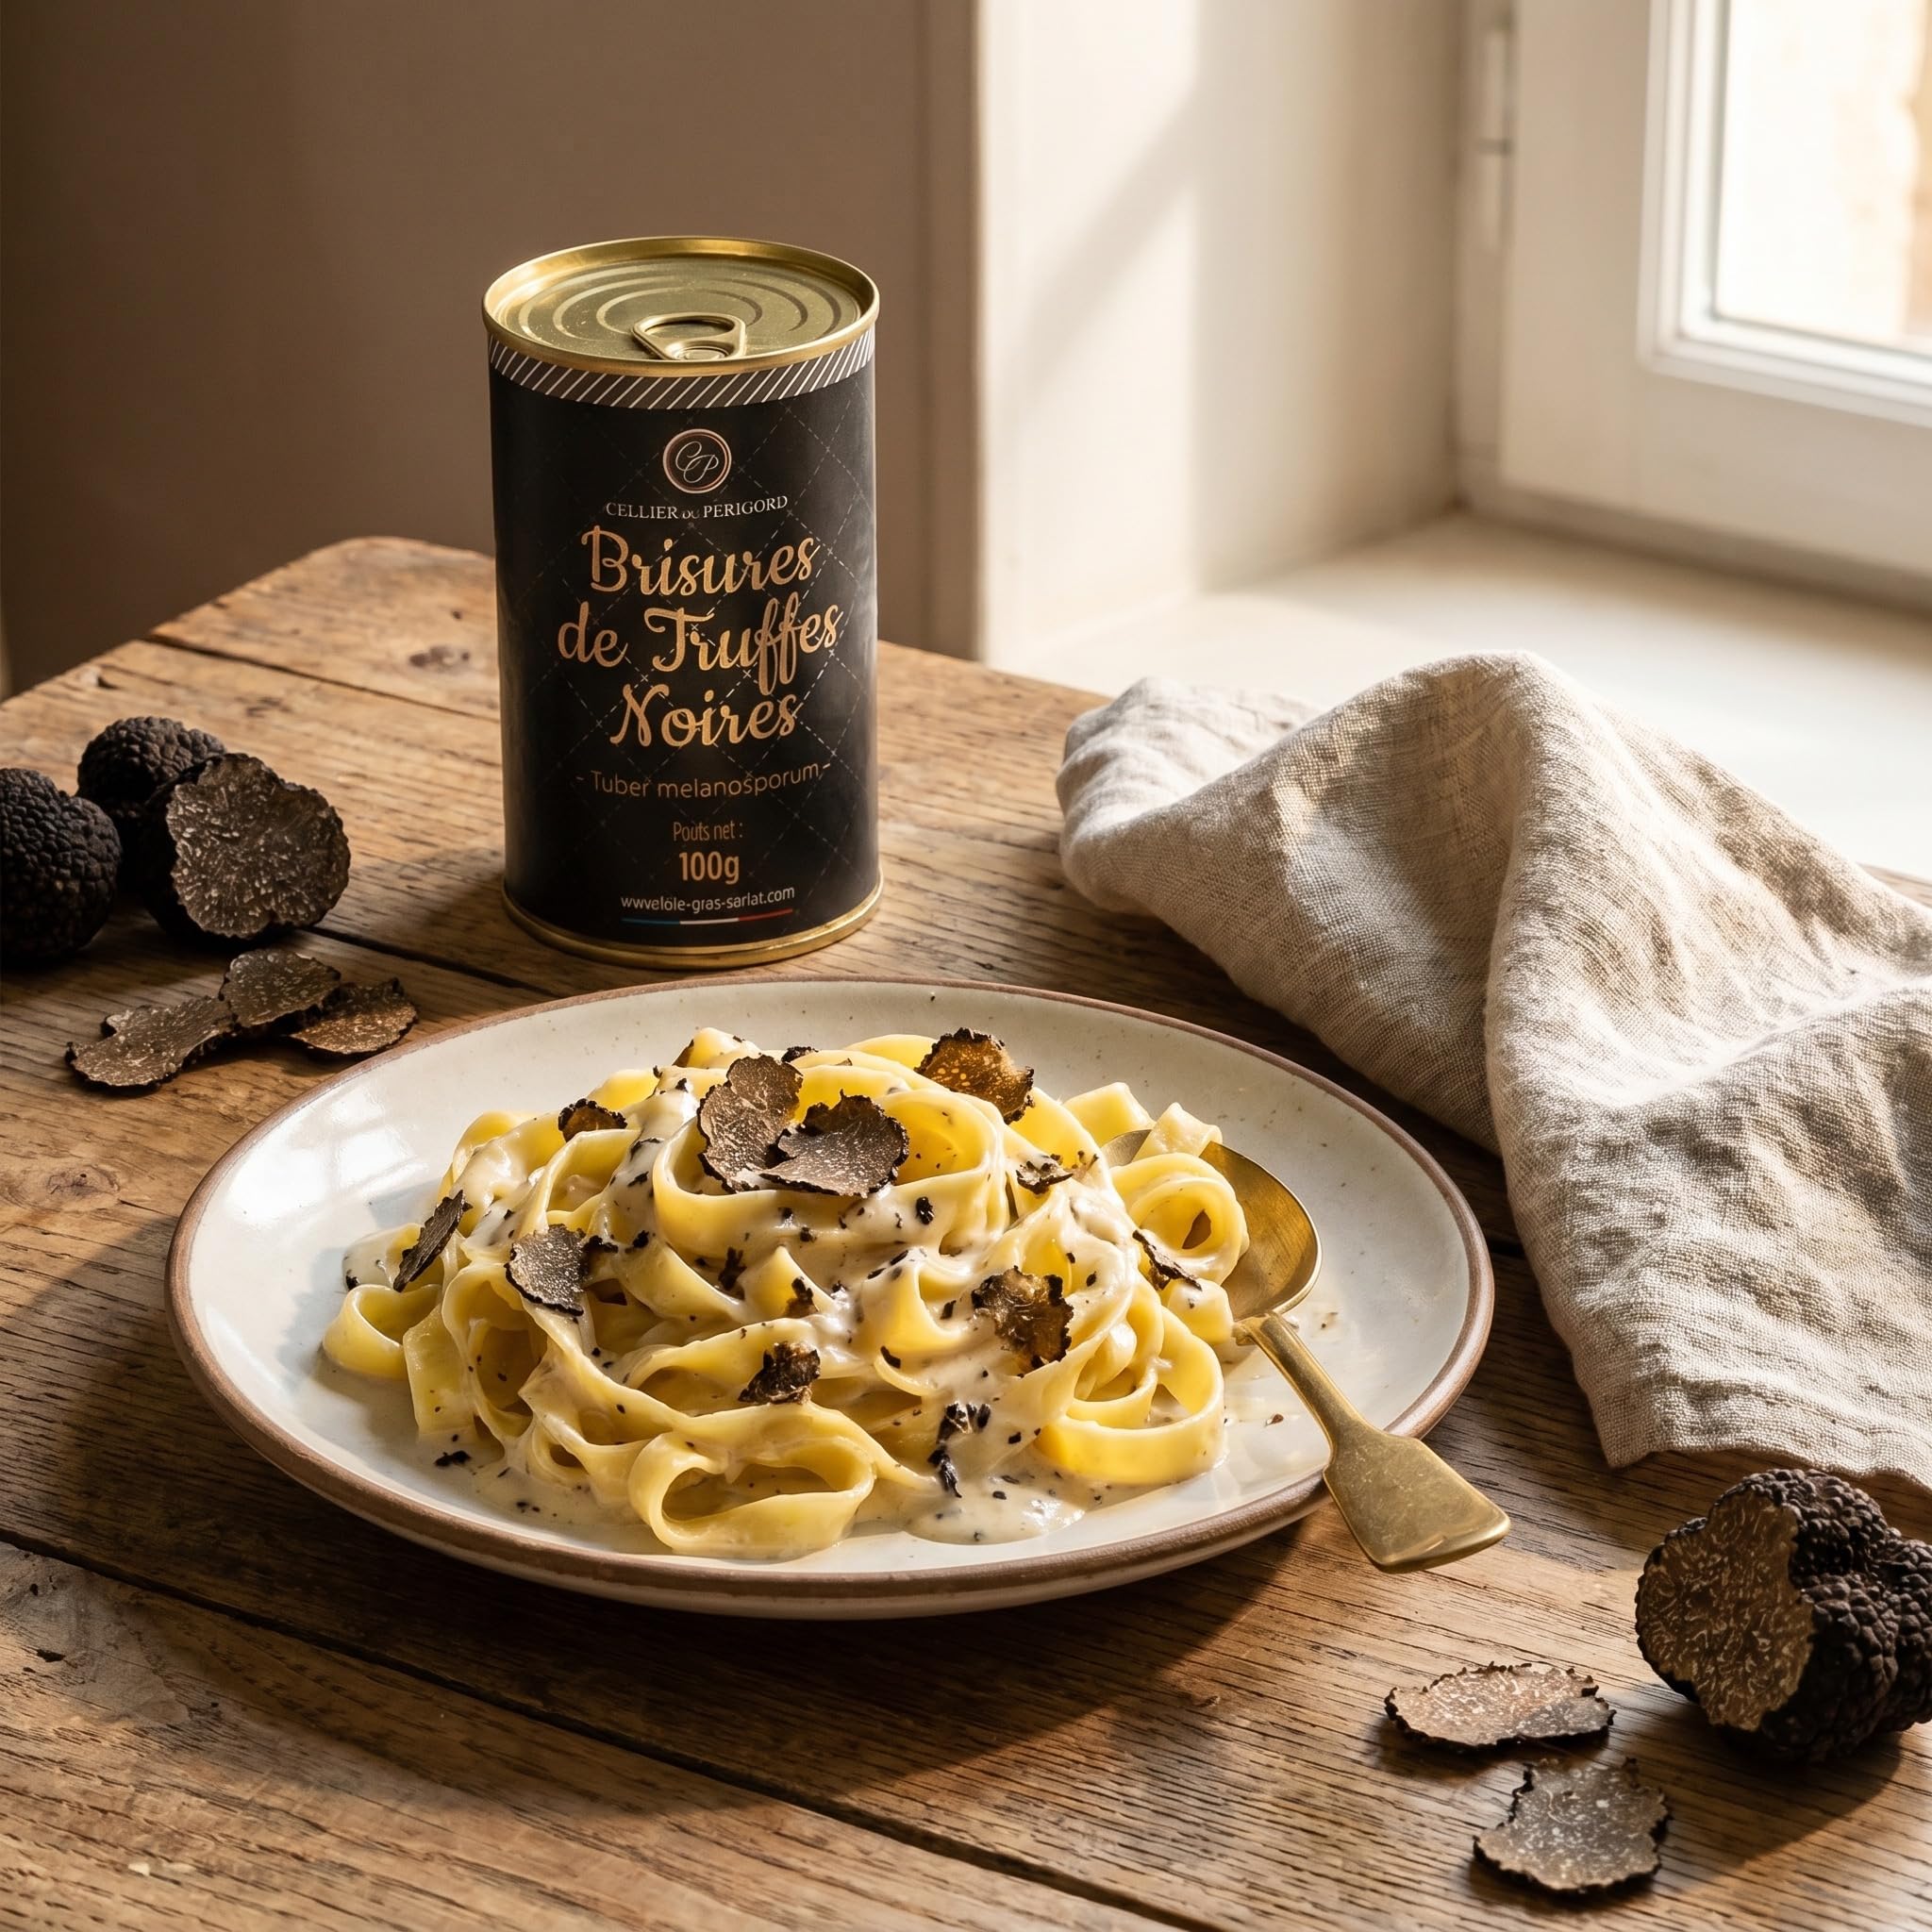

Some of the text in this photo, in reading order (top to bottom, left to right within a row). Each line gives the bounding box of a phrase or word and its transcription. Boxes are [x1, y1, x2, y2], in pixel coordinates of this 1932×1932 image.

[606, 502, 679, 520] CELLIER
[703, 495, 789, 518] PERIGORD
[581, 525, 821, 596] Brisures
[558, 591, 843, 695] de Truffes
[609, 683, 798, 747] Noires
[591, 770, 648, 797] Tuber
[713, 820, 735, 841] net
[678, 851, 740, 885] 100g
